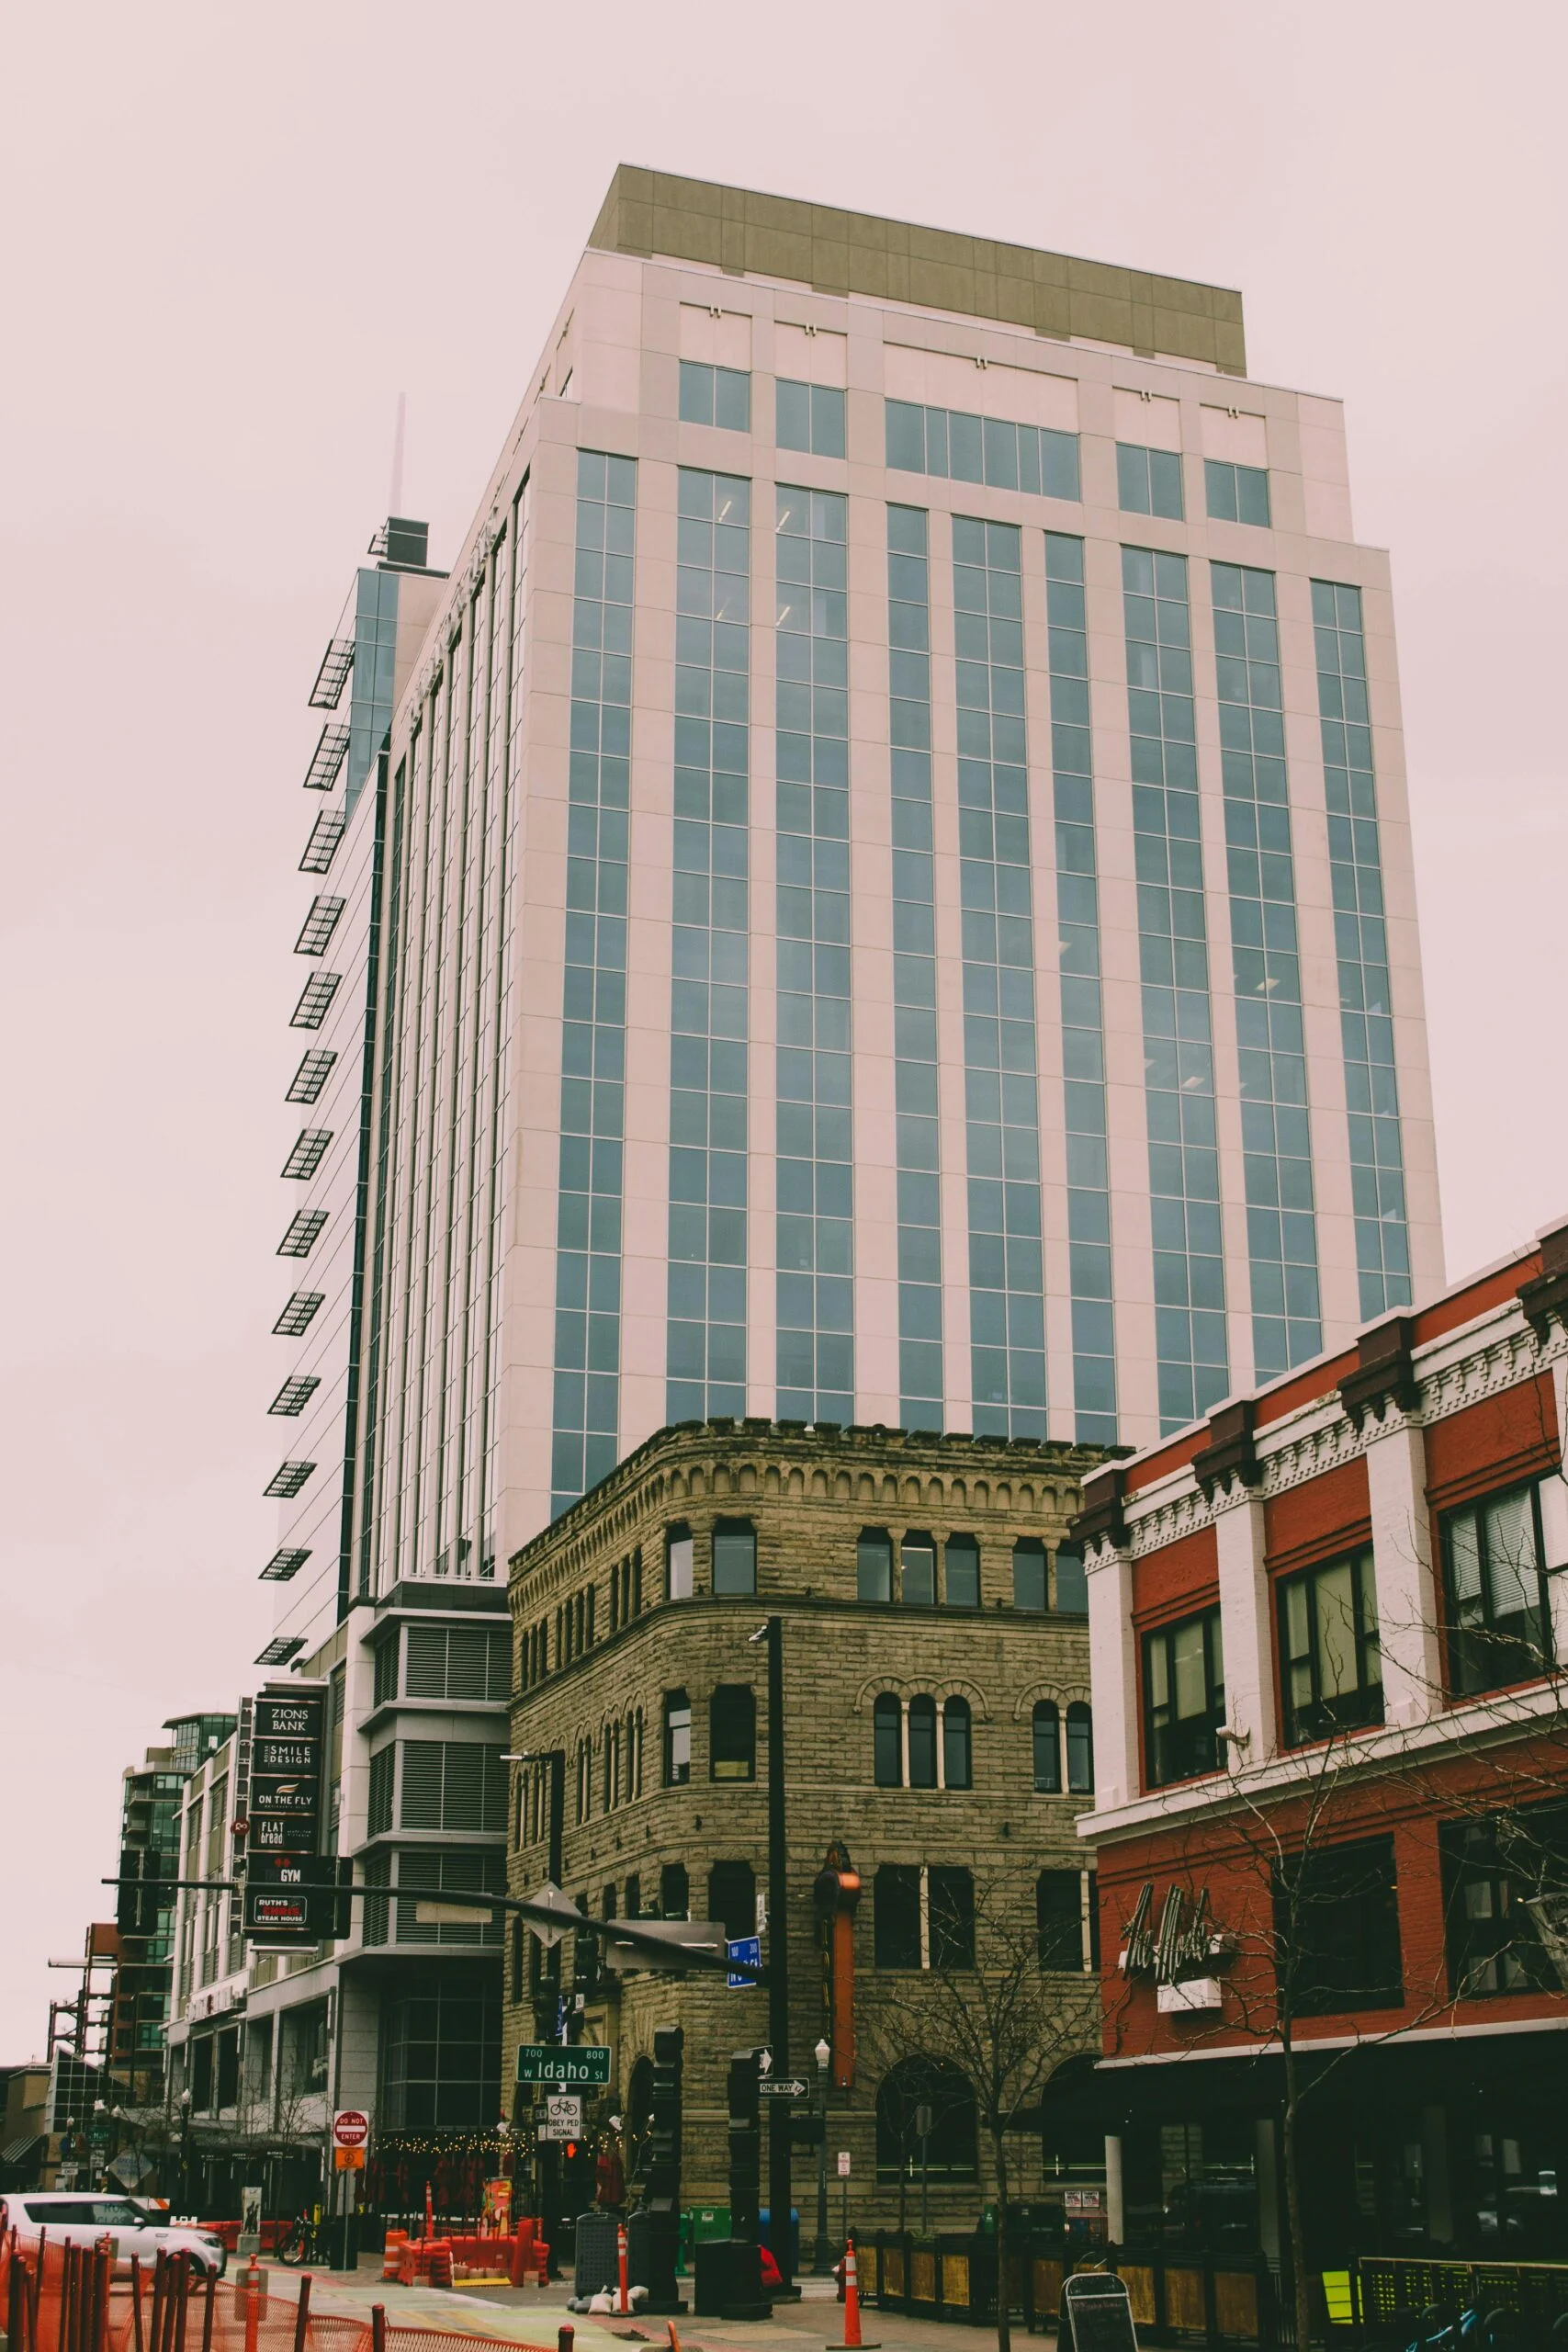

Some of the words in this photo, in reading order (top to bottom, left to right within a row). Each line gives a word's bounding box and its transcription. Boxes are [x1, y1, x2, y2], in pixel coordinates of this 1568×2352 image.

[271, 1708, 308, 1720] ZIONS
[272, 1720, 306, 1731] BANK
[270, 1745, 311, 1756] SMILE
[270, 1755, 311, 1764] DESIGN
[258, 1795, 272, 1804] ON
[274, 1795, 293, 1804] THE
[294, 1796, 312, 1805] FLY
[262, 1821, 284, 1832] FLAT
[261, 1832, 283, 1845] bread
[280, 1869, 301, 1882] GYM
[525, 2049, 542, 2058] 700
[586, 2050, 604, 2059] 800
[524, 2069, 532, 2078] W
[538, 2061, 589, 2079] Idaho
[595, 2070, 603, 2079] St
